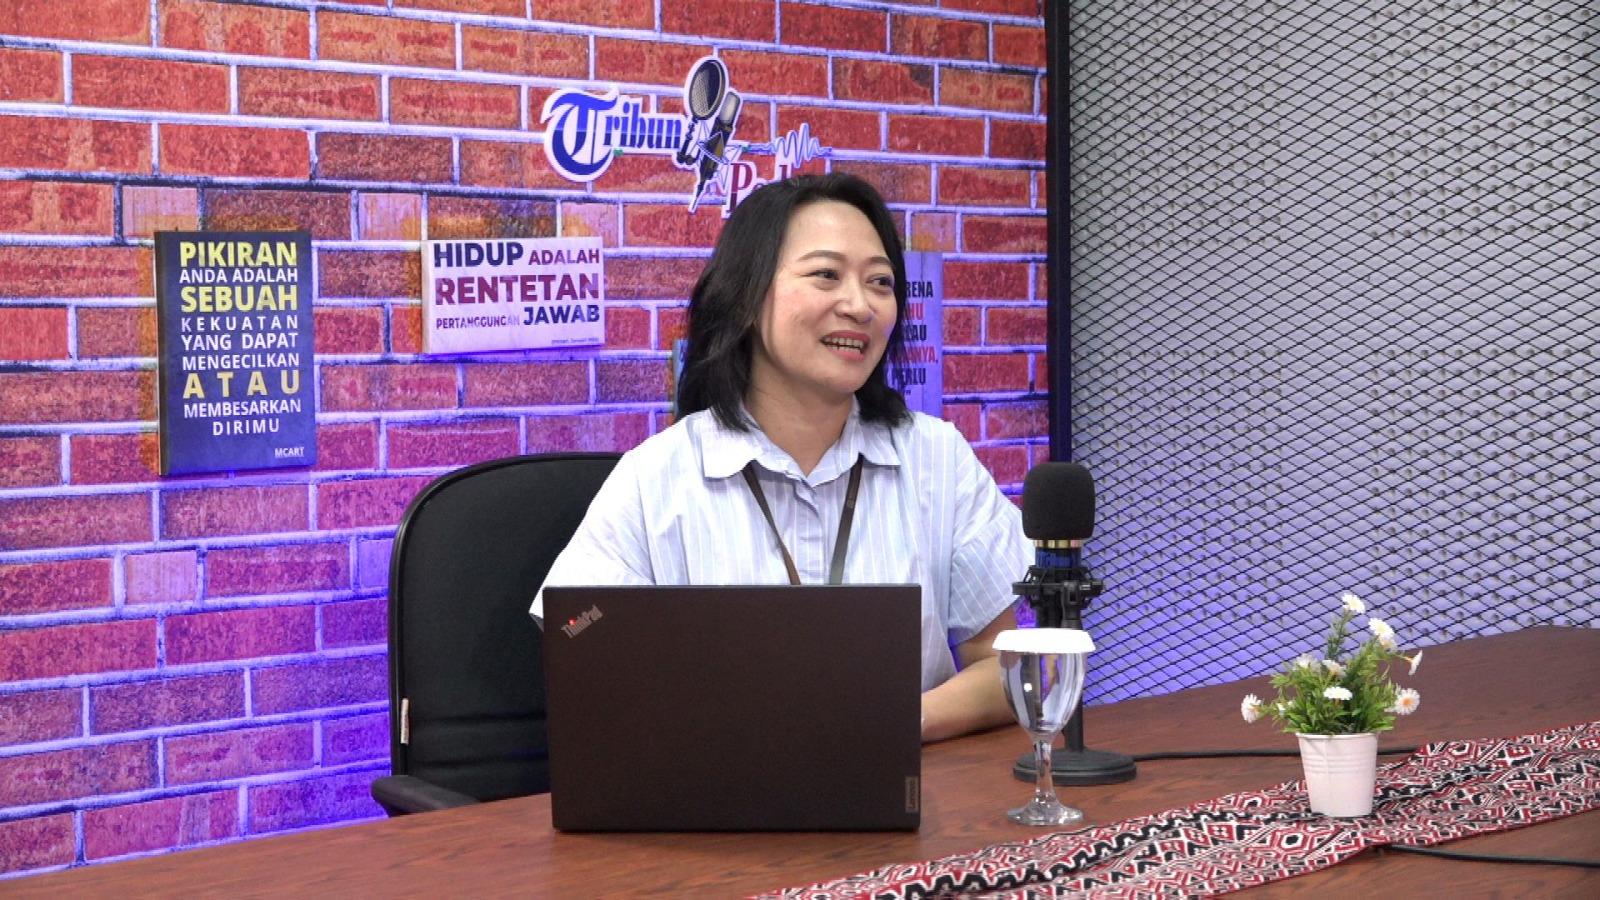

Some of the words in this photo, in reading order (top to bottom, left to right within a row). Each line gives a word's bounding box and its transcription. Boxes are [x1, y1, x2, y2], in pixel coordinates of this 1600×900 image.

[550, 92, 682, 175] Tribun
[180, 241, 297, 268] PIKIRAN
[434, 242, 524, 268] HIDUP
[528, 248, 600, 265] ADALAH
[179, 269, 228, 284] ANDA
[232, 268, 298, 283] ADALAH
[181, 285, 298, 313] SEBUAH
[435, 273, 599, 306] RENTETAN
[905, 281, 933, 298] RENA
[181, 315, 298, 332] KEKUATAN
[523, 305, 600, 326] JAWAB
[181, 334, 232, 351] YANG
[242, 333, 299, 350] DAPAT
[182, 353, 300, 371] MENGECILKAN
[183, 370, 300, 399] ATAU
[184, 399, 302, 418] MEMBESARKAN
[212, 418, 280, 436] DIRIMU
